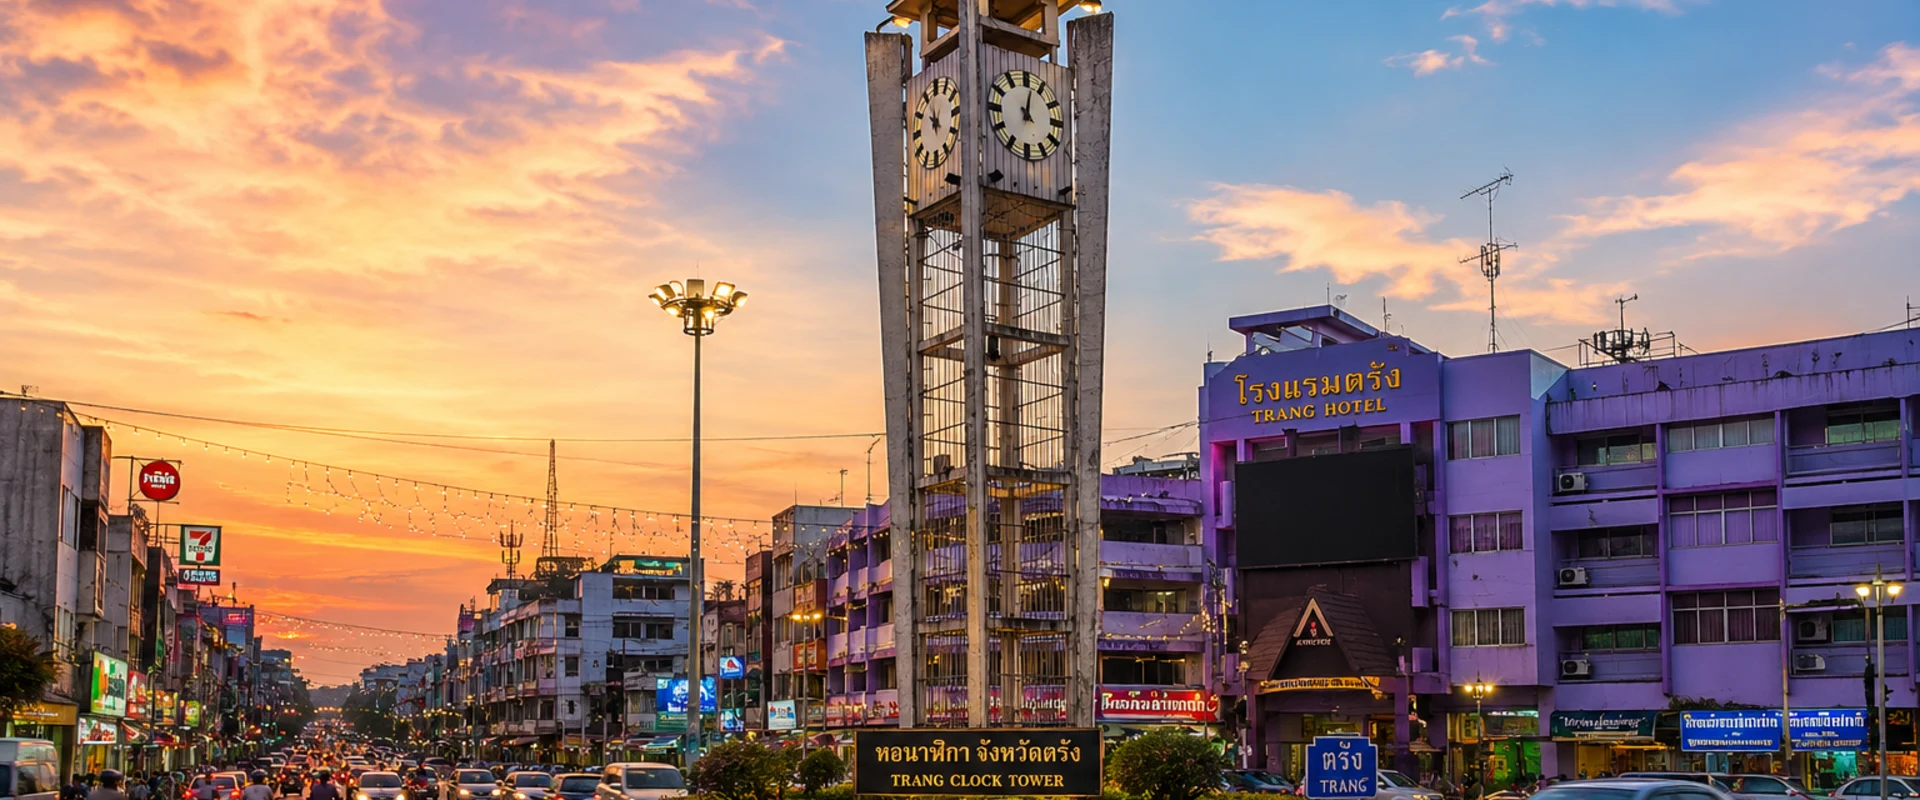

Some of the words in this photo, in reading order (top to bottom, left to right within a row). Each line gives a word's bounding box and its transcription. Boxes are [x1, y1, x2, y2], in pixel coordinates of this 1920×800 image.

[1234, 361, 1400, 405] โรงแรมตรัง
[1252, 404, 1315, 423] TRANG
[1325, 397, 1386, 416] HOTEL
[976, 738, 1081, 763] จังหวัดตรัง
[890, 773, 945, 788] TRANG
[949, 773, 1003, 788] CLOCK
[1007, 773, 1065, 788] TOWER
[1320, 777, 1369, 793] TRANG
